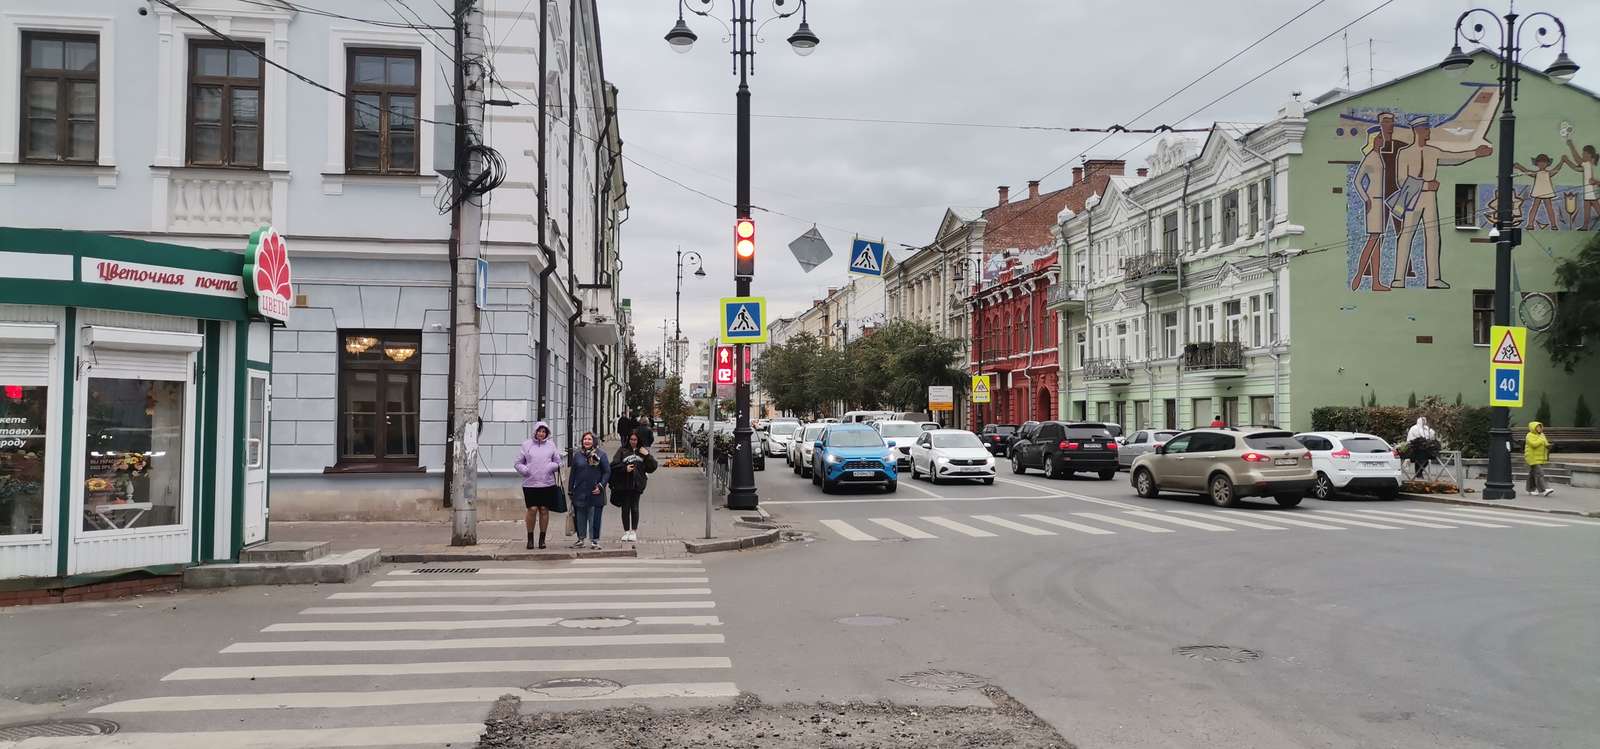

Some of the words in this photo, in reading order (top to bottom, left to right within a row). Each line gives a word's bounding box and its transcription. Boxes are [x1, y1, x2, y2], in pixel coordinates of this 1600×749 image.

[97, 262, 185, 286] Цветочная
[195, 276, 238, 292] почта
[262, 295, 288, 317] ЦВЕТЫ
[719, 368, 731, 381] 02
[1499, 377, 1516, 392] 40
